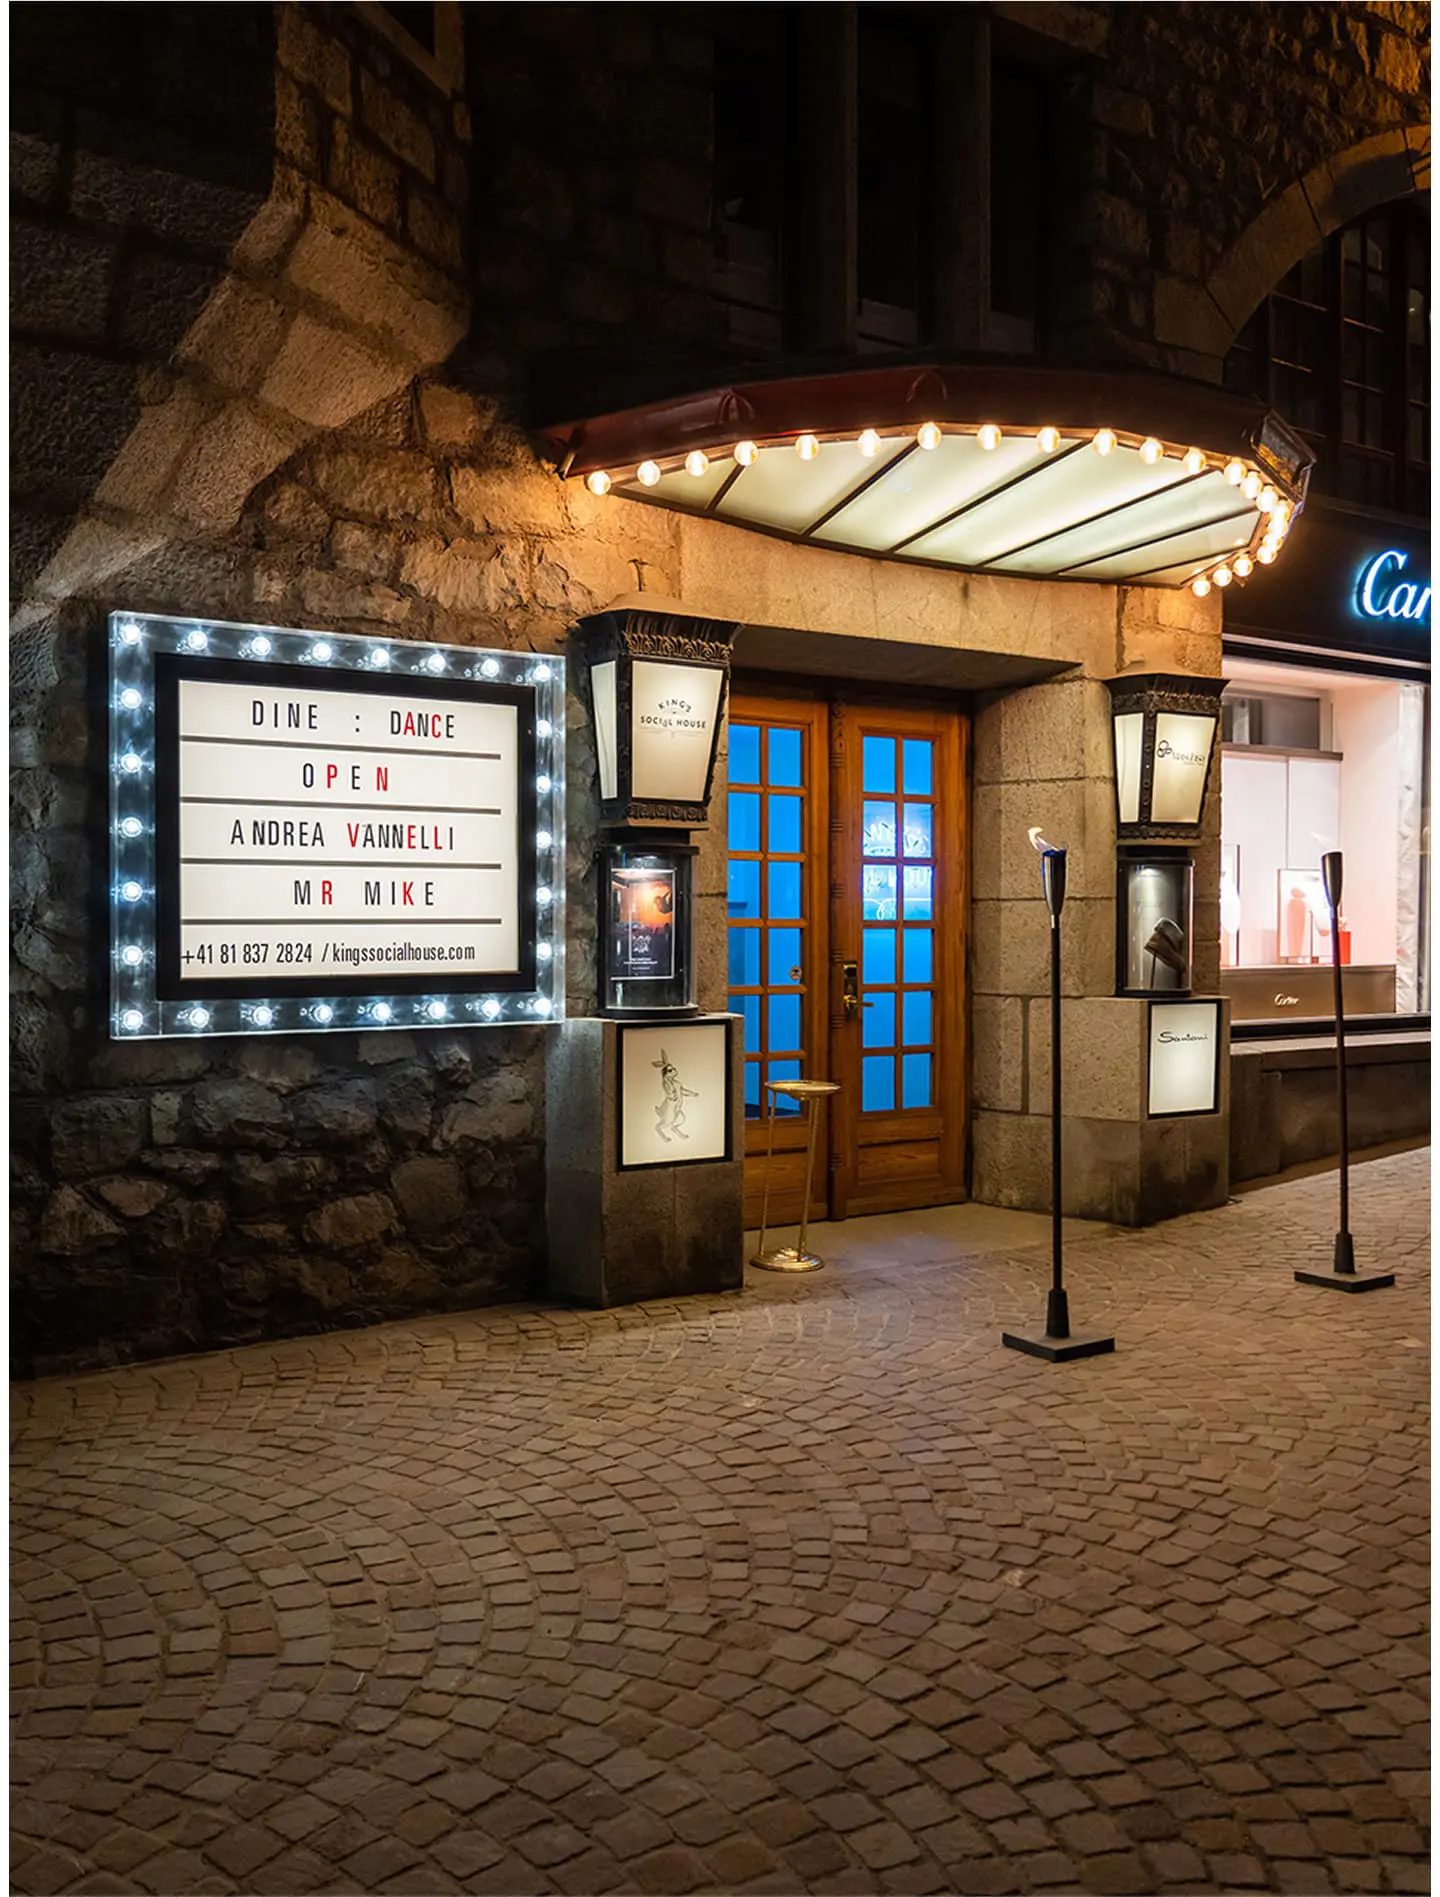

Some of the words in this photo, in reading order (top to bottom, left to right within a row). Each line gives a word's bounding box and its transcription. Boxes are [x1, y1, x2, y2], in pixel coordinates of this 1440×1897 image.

[252, 700, 318, 730] DINE
[355, 714, 360, 733] :
[390, 710, 455, 739] DANCE
[640, 715, 673, 728] SOCIAL
[676, 719, 706, 729] HOUSE
[302, 763, 389, 792] OPEN
[230, 819, 326, 848] ANDREA
[346, 822, 454, 851] VANNELLI
[294, 880, 333, 906] MR
[364, 881, 434, 907] MIKE
[181, 943, 213, 965] +41
[220, 943, 237, 964] 81
[242, 943, 269, 964] 837
[276, 942, 313, 963] 2824
